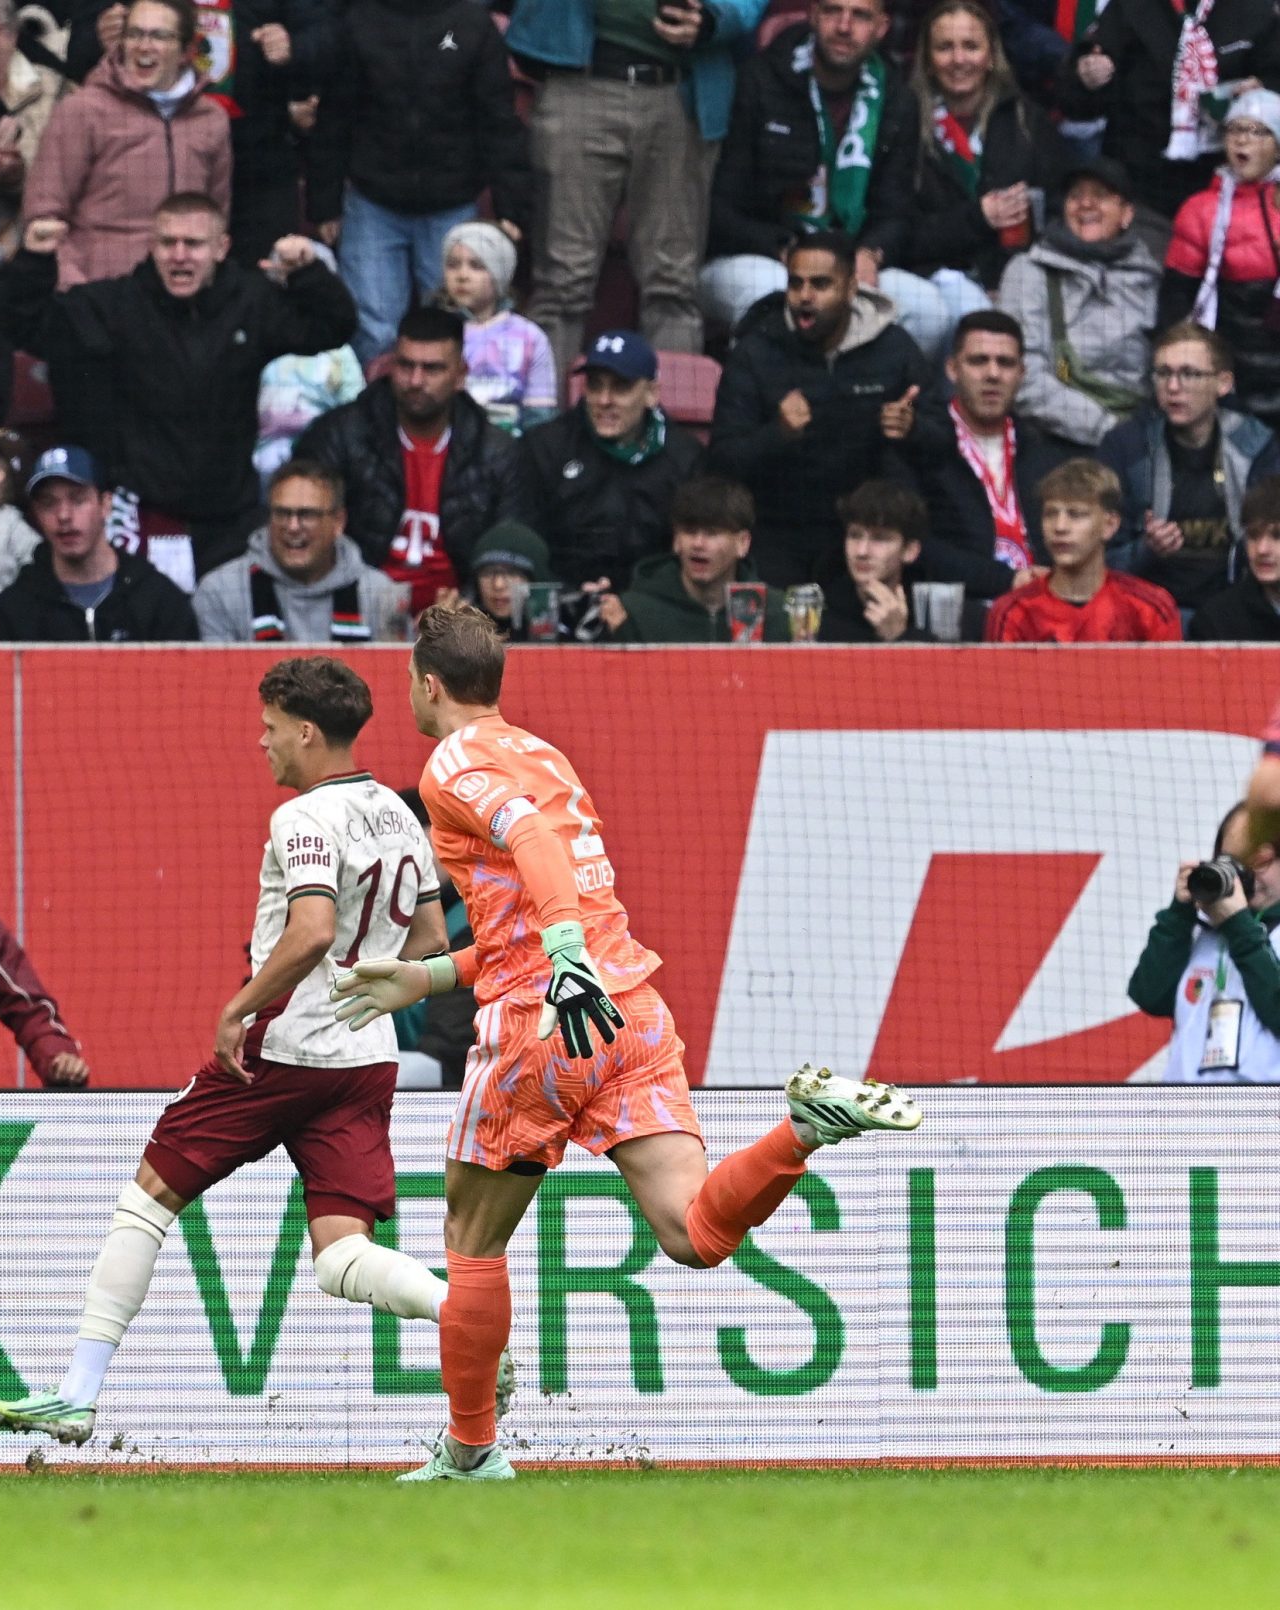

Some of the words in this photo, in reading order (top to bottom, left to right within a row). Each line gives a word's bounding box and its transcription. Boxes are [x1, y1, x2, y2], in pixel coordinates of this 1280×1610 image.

[473, 784, 509, 818] Allianz
[539, 759, 606, 860] 1
[286, 832, 331, 853] sieg-
[287, 852, 331, 869] mund
[573, 860, 615, 895] NEUE
[336, 854, 422, 968] 10
